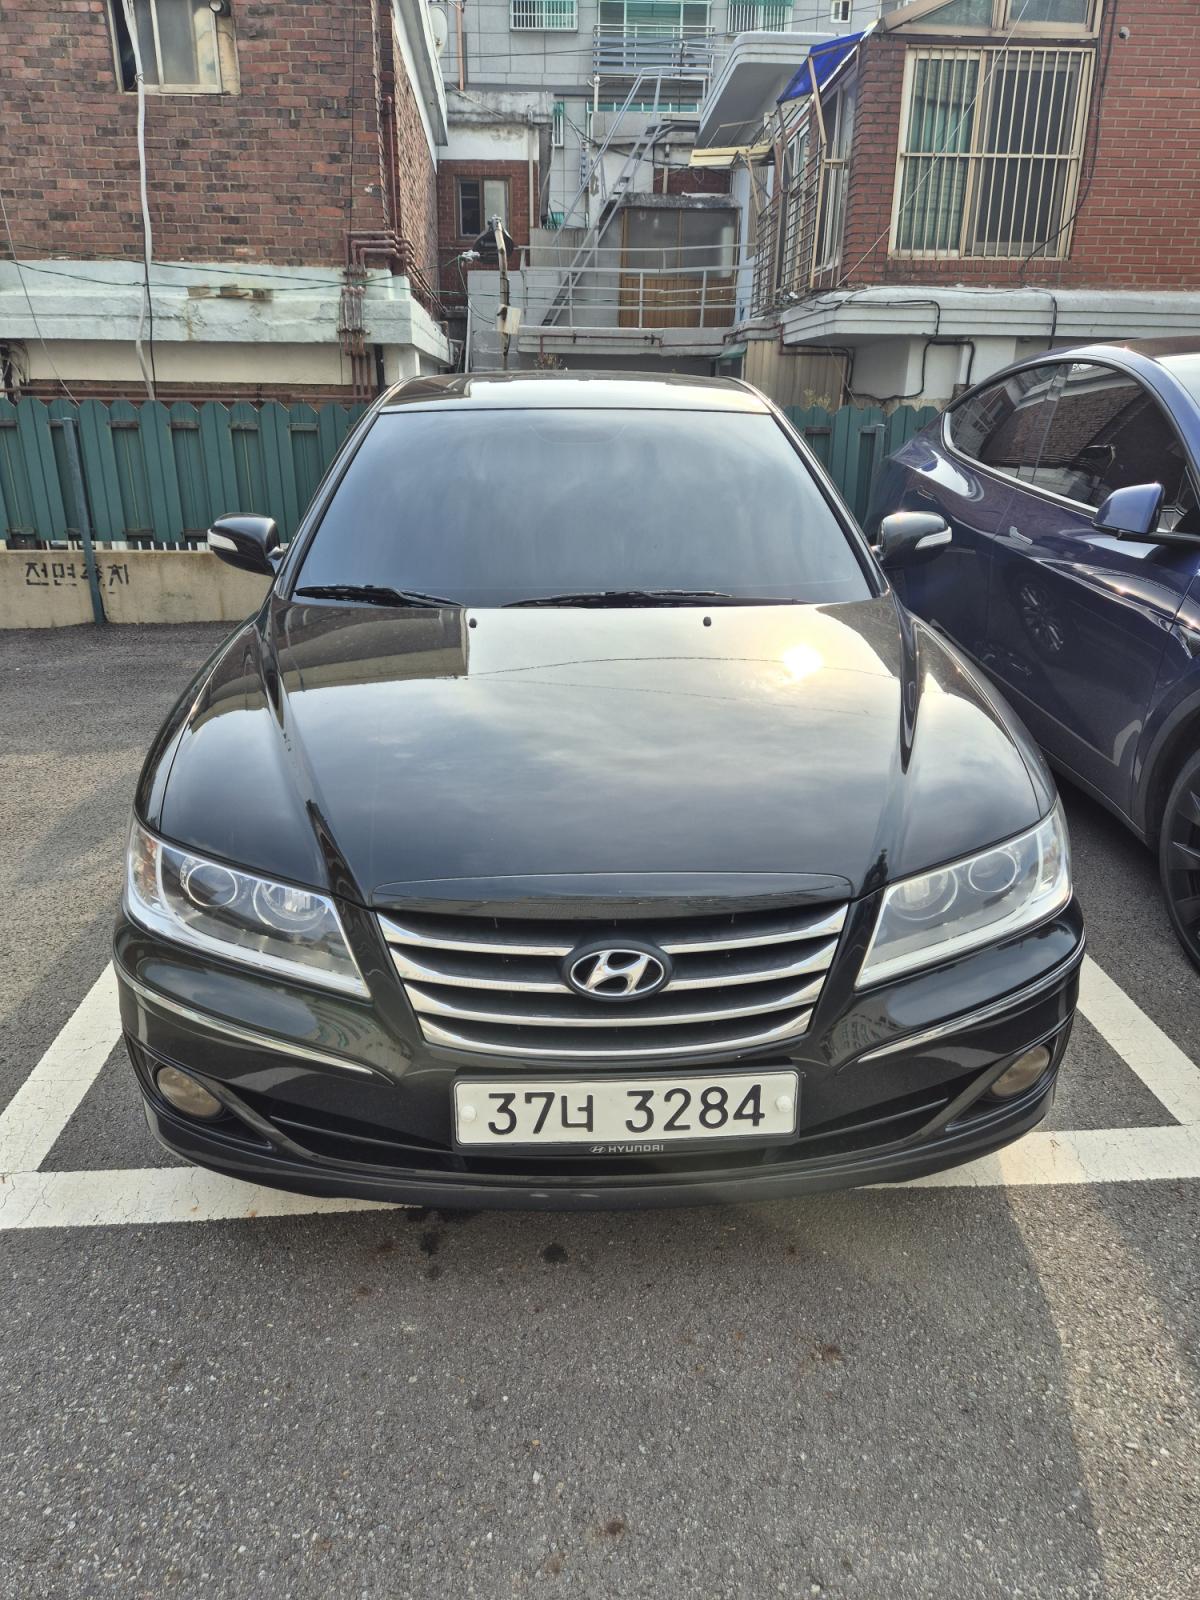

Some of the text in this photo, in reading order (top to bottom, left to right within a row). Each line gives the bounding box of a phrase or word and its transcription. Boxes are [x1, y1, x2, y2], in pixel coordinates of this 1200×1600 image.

[487, 1084, 765, 1136] 37너 3284
[608, 1144, 664, 1153] HYUNDAI
